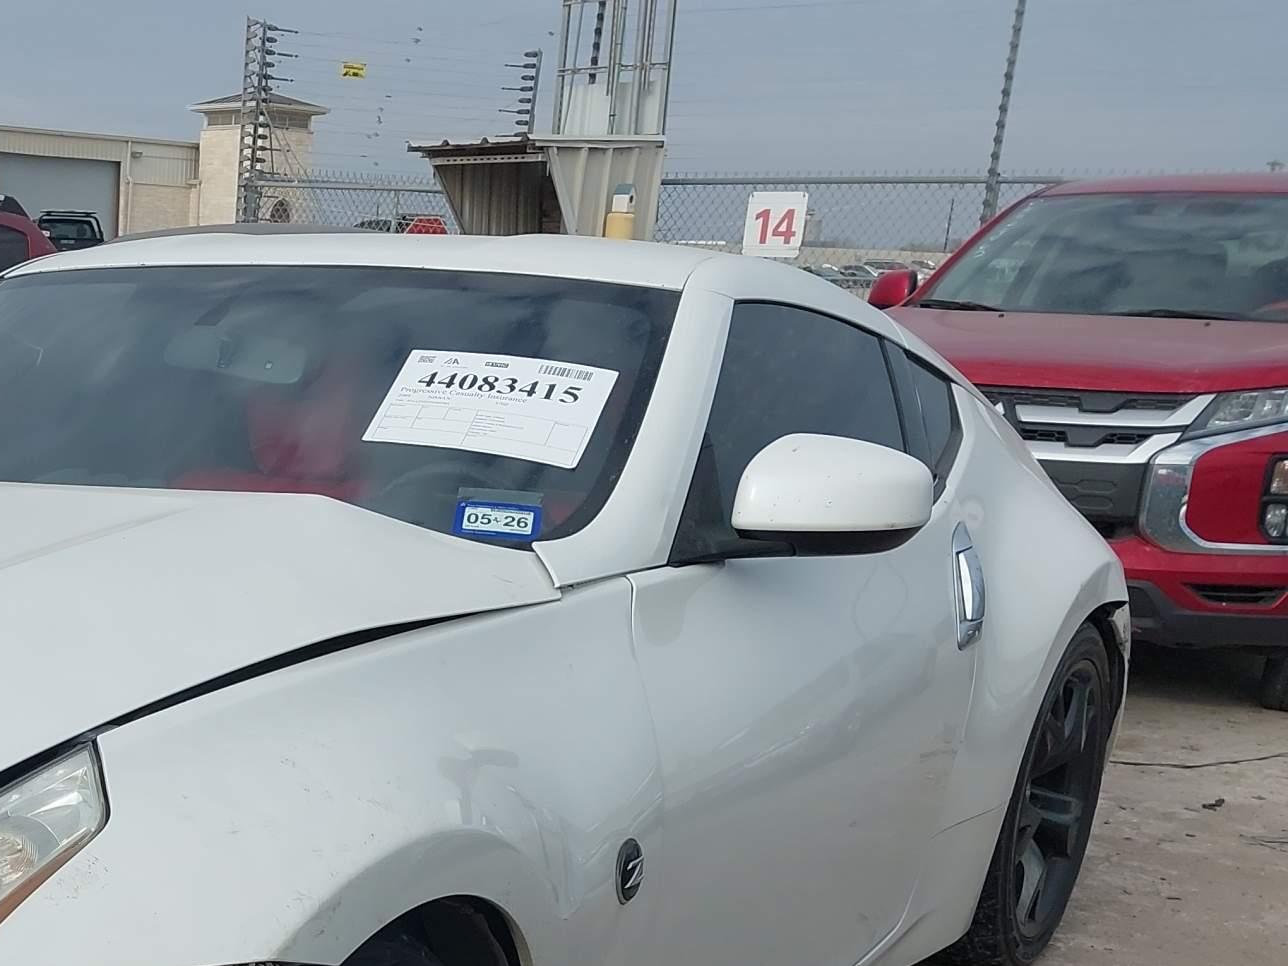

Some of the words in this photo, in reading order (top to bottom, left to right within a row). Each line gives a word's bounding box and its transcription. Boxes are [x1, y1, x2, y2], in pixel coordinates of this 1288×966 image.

[755, 208, 796, 245] 14
[401, 386, 447, 395] Progressive
[449, 390, 484, 399] Casualty
[488, 393, 528, 403] Insurance
[417, 371, 582, 404] 44083415
[467, 512, 492, 525] 05
[503, 515, 529, 529] 26
